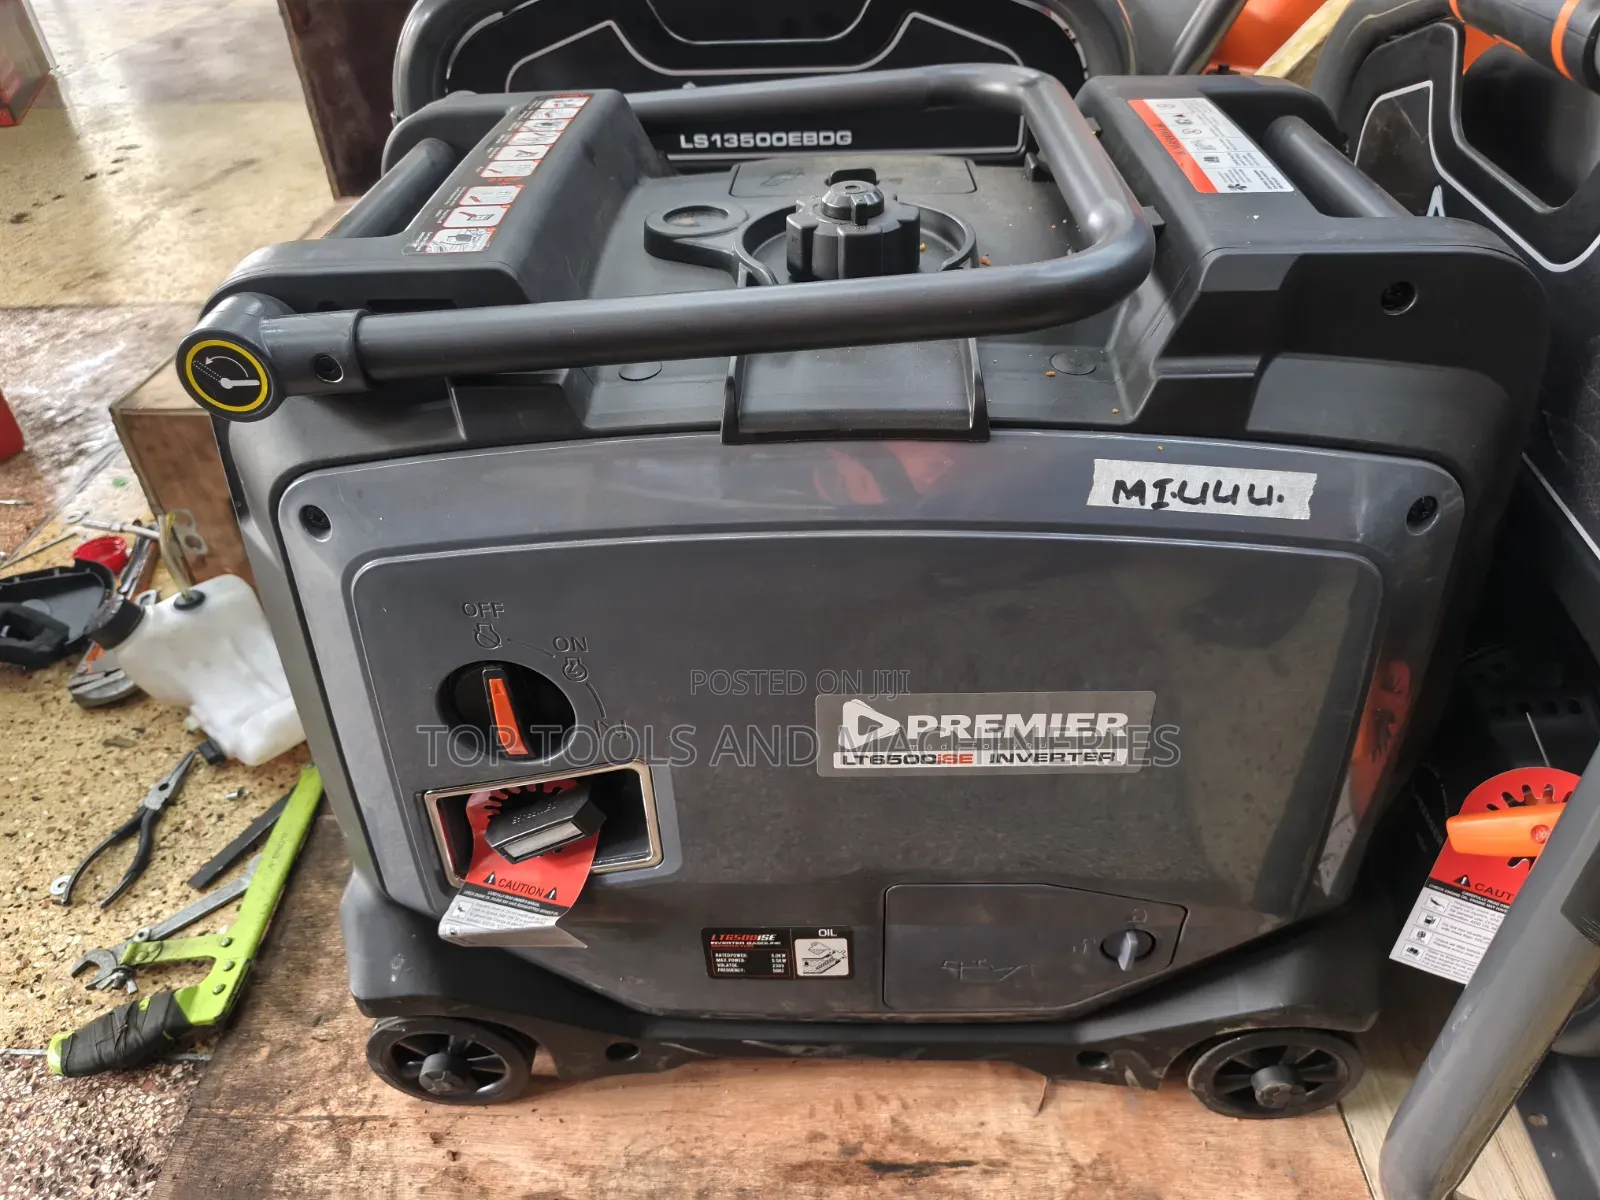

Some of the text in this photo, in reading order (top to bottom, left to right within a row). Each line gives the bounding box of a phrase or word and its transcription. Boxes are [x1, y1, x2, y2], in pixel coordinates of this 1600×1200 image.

[679, 130, 853, 149] LS13500EBDG
[461, 601, 506, 619] OFF
[552, 635, 589, 653] ON
[906, 711, 1129, 740] PREMIER
[989, 751, 1116, 765] INVERTER
[498, 878, 545, 897] CAUTION
[1474, 882, 1514, 900] CAUT
[818, 928, 837, 937] OIL
